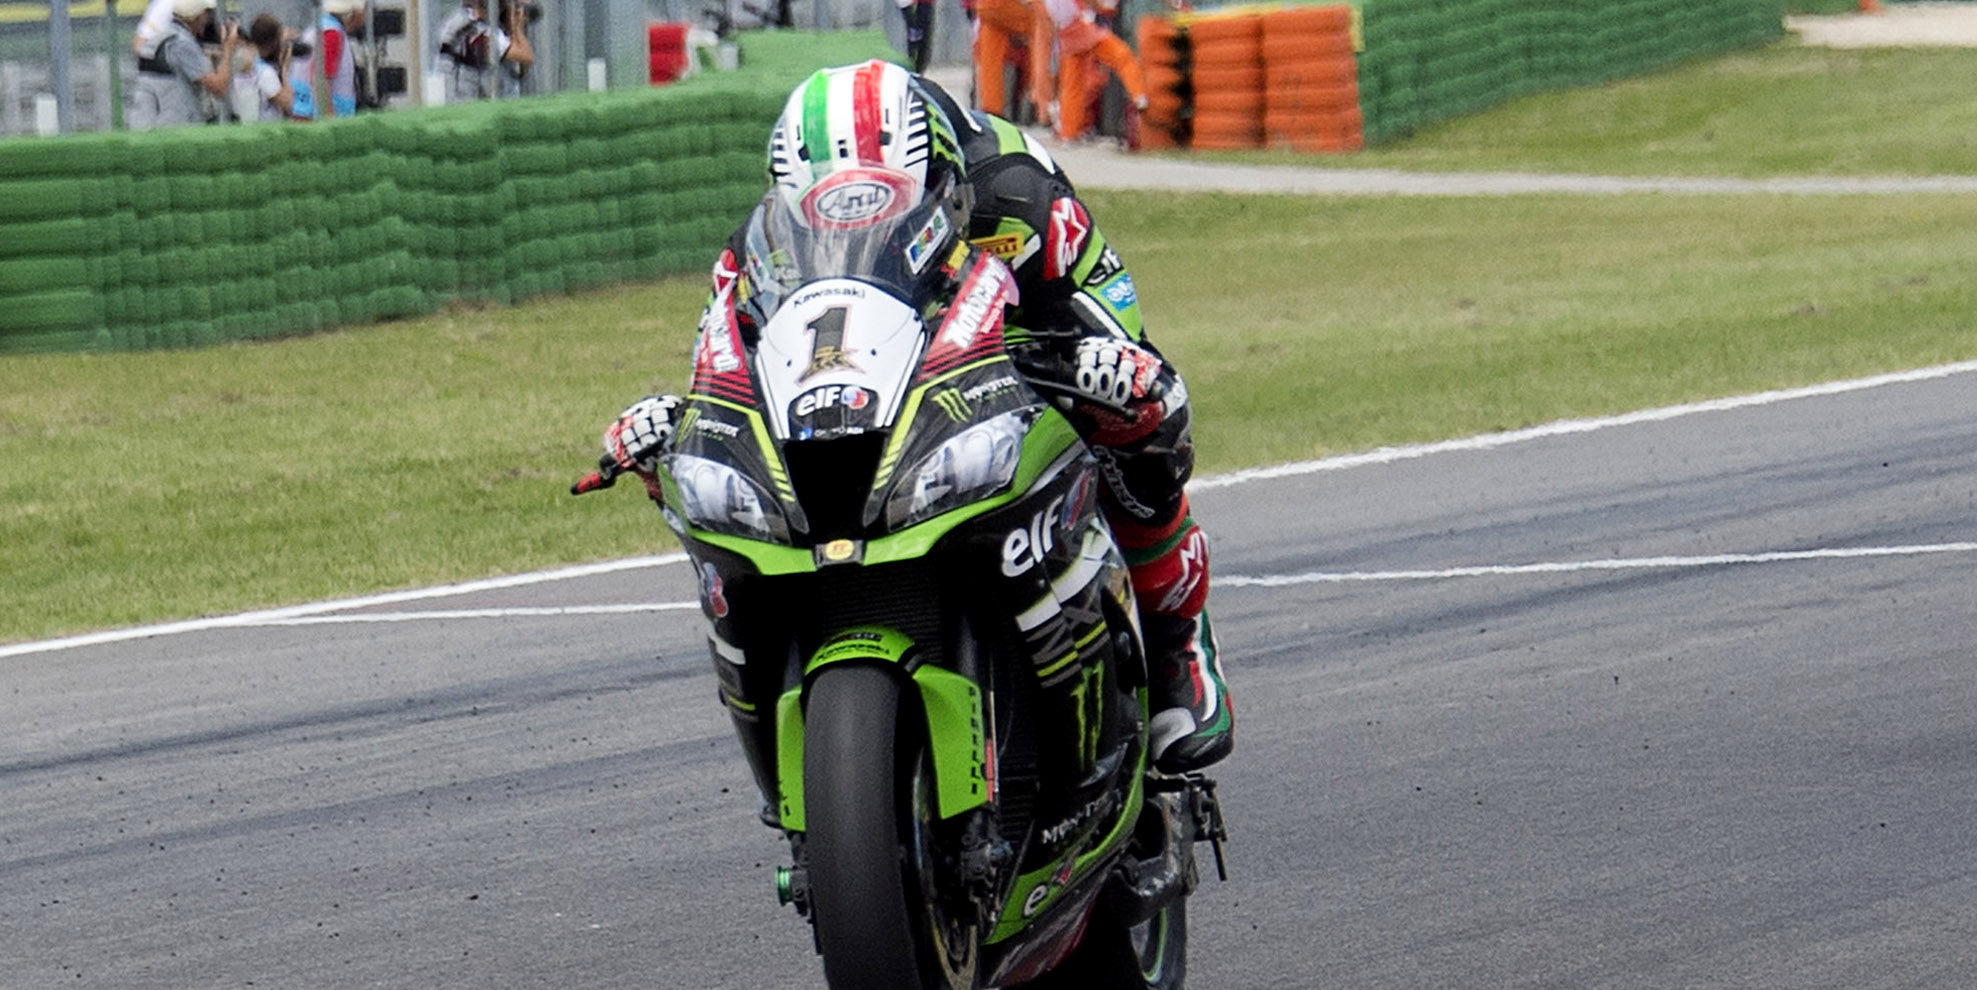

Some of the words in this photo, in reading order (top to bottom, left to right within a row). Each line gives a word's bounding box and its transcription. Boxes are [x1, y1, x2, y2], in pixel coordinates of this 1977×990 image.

[794, 286, 865, 308] Kawasaki
[797, 304, 866, 383] 1
[796, 385, 841, 417] elf
[1001, 493, 1066, 578] elf
